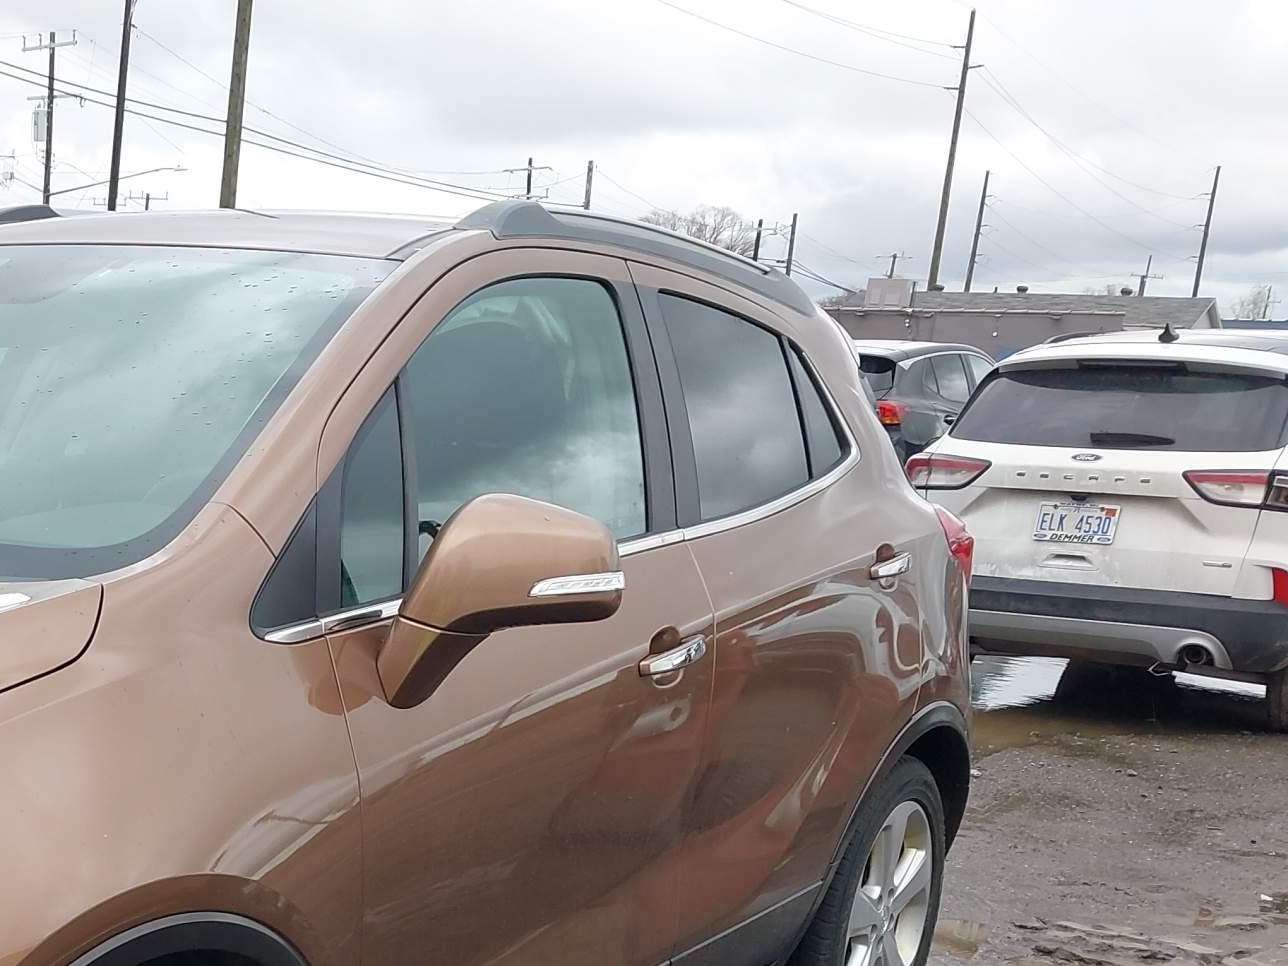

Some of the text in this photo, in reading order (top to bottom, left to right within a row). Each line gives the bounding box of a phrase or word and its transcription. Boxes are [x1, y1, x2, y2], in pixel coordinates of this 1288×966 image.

[1039, 513, 1112, 535] ELK 4530
[1049, 533, 1095, 543] DEMMER
